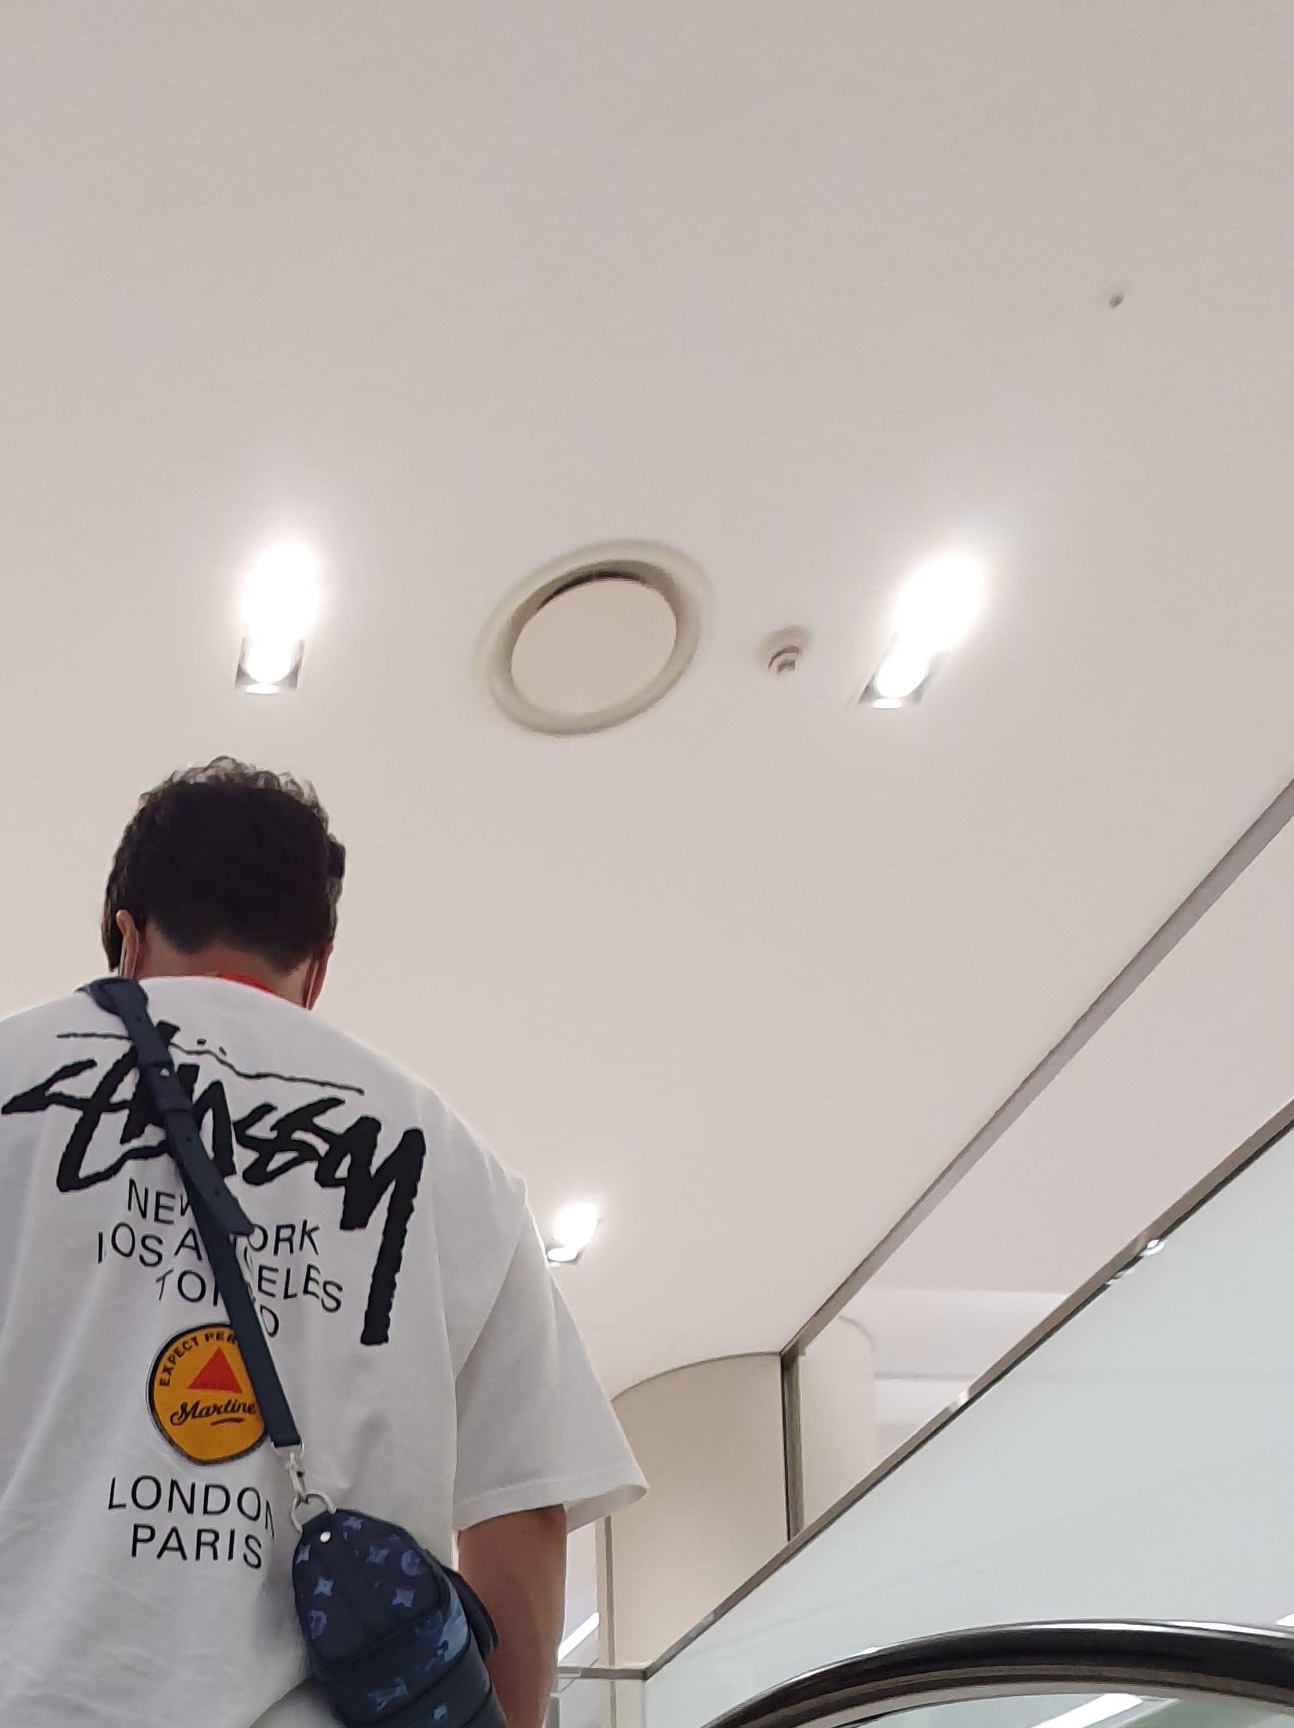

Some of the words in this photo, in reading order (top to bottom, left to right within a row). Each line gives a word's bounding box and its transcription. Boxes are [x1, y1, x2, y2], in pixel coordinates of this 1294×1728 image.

[246, 1219, 320, 1256] ORK
[173, 1227, 343, 1312] AELES
[159, 1336, 199, 1386] EXPECT
[131, 1523, 262, 1569] PARIS
